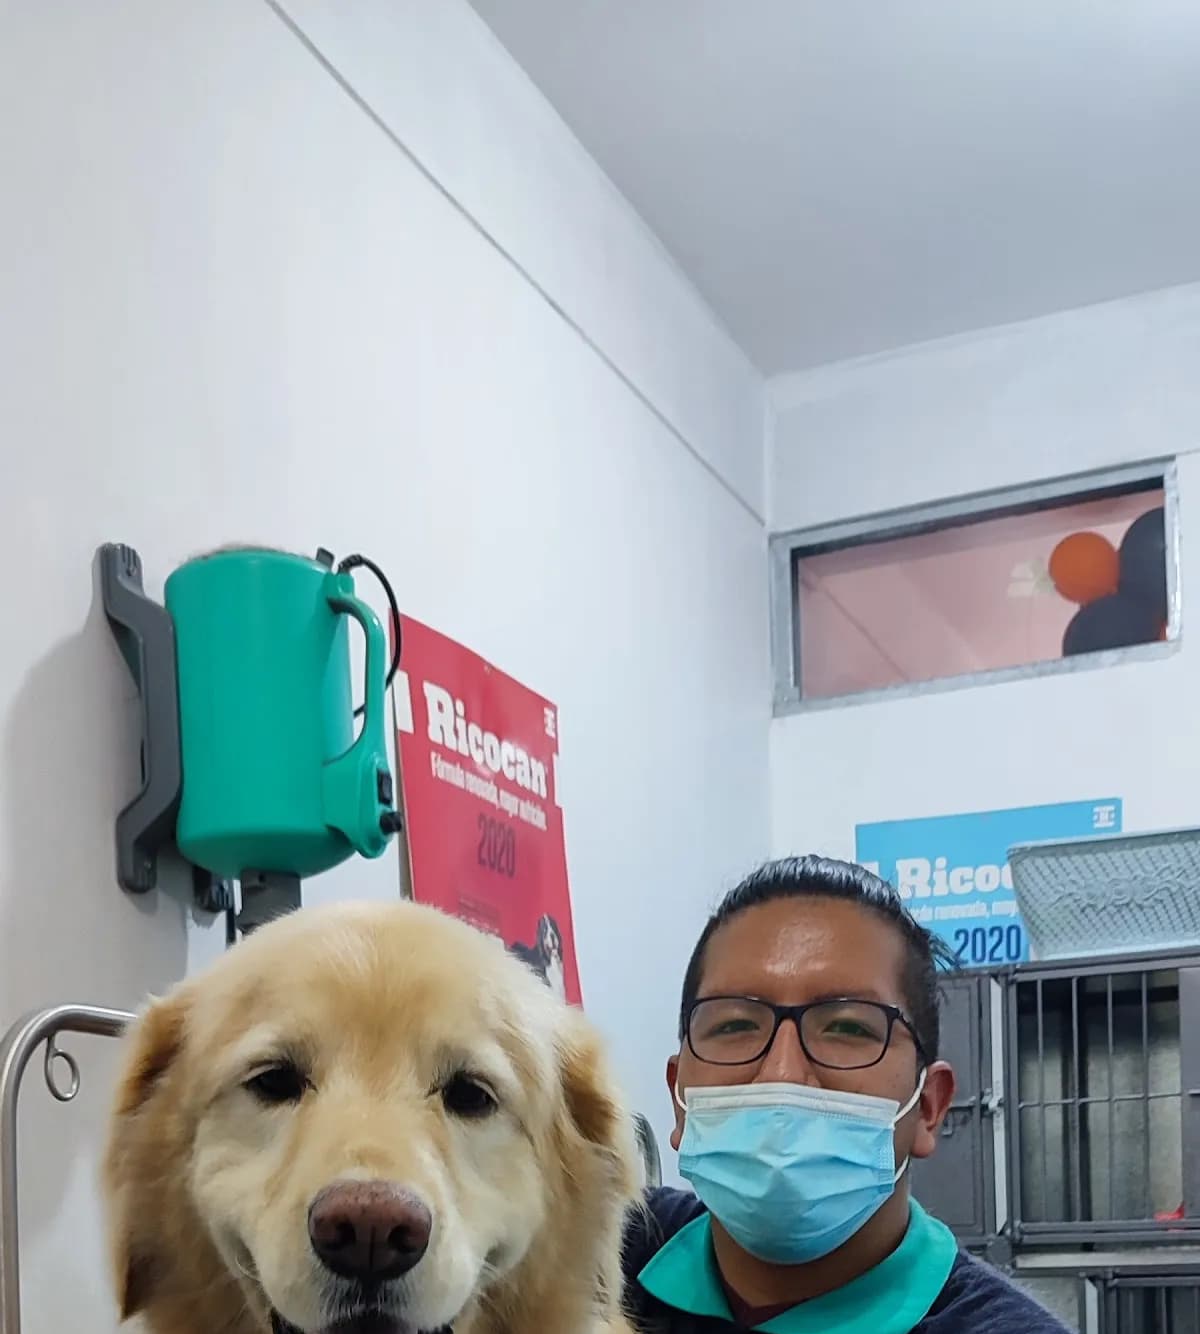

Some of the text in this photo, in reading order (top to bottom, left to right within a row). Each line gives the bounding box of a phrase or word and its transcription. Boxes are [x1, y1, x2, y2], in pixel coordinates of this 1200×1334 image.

[423, 680, 547, 798] Ricocan
[477, 812, 516, 879] 2020
[954, 925, 1021, 965] 2020
